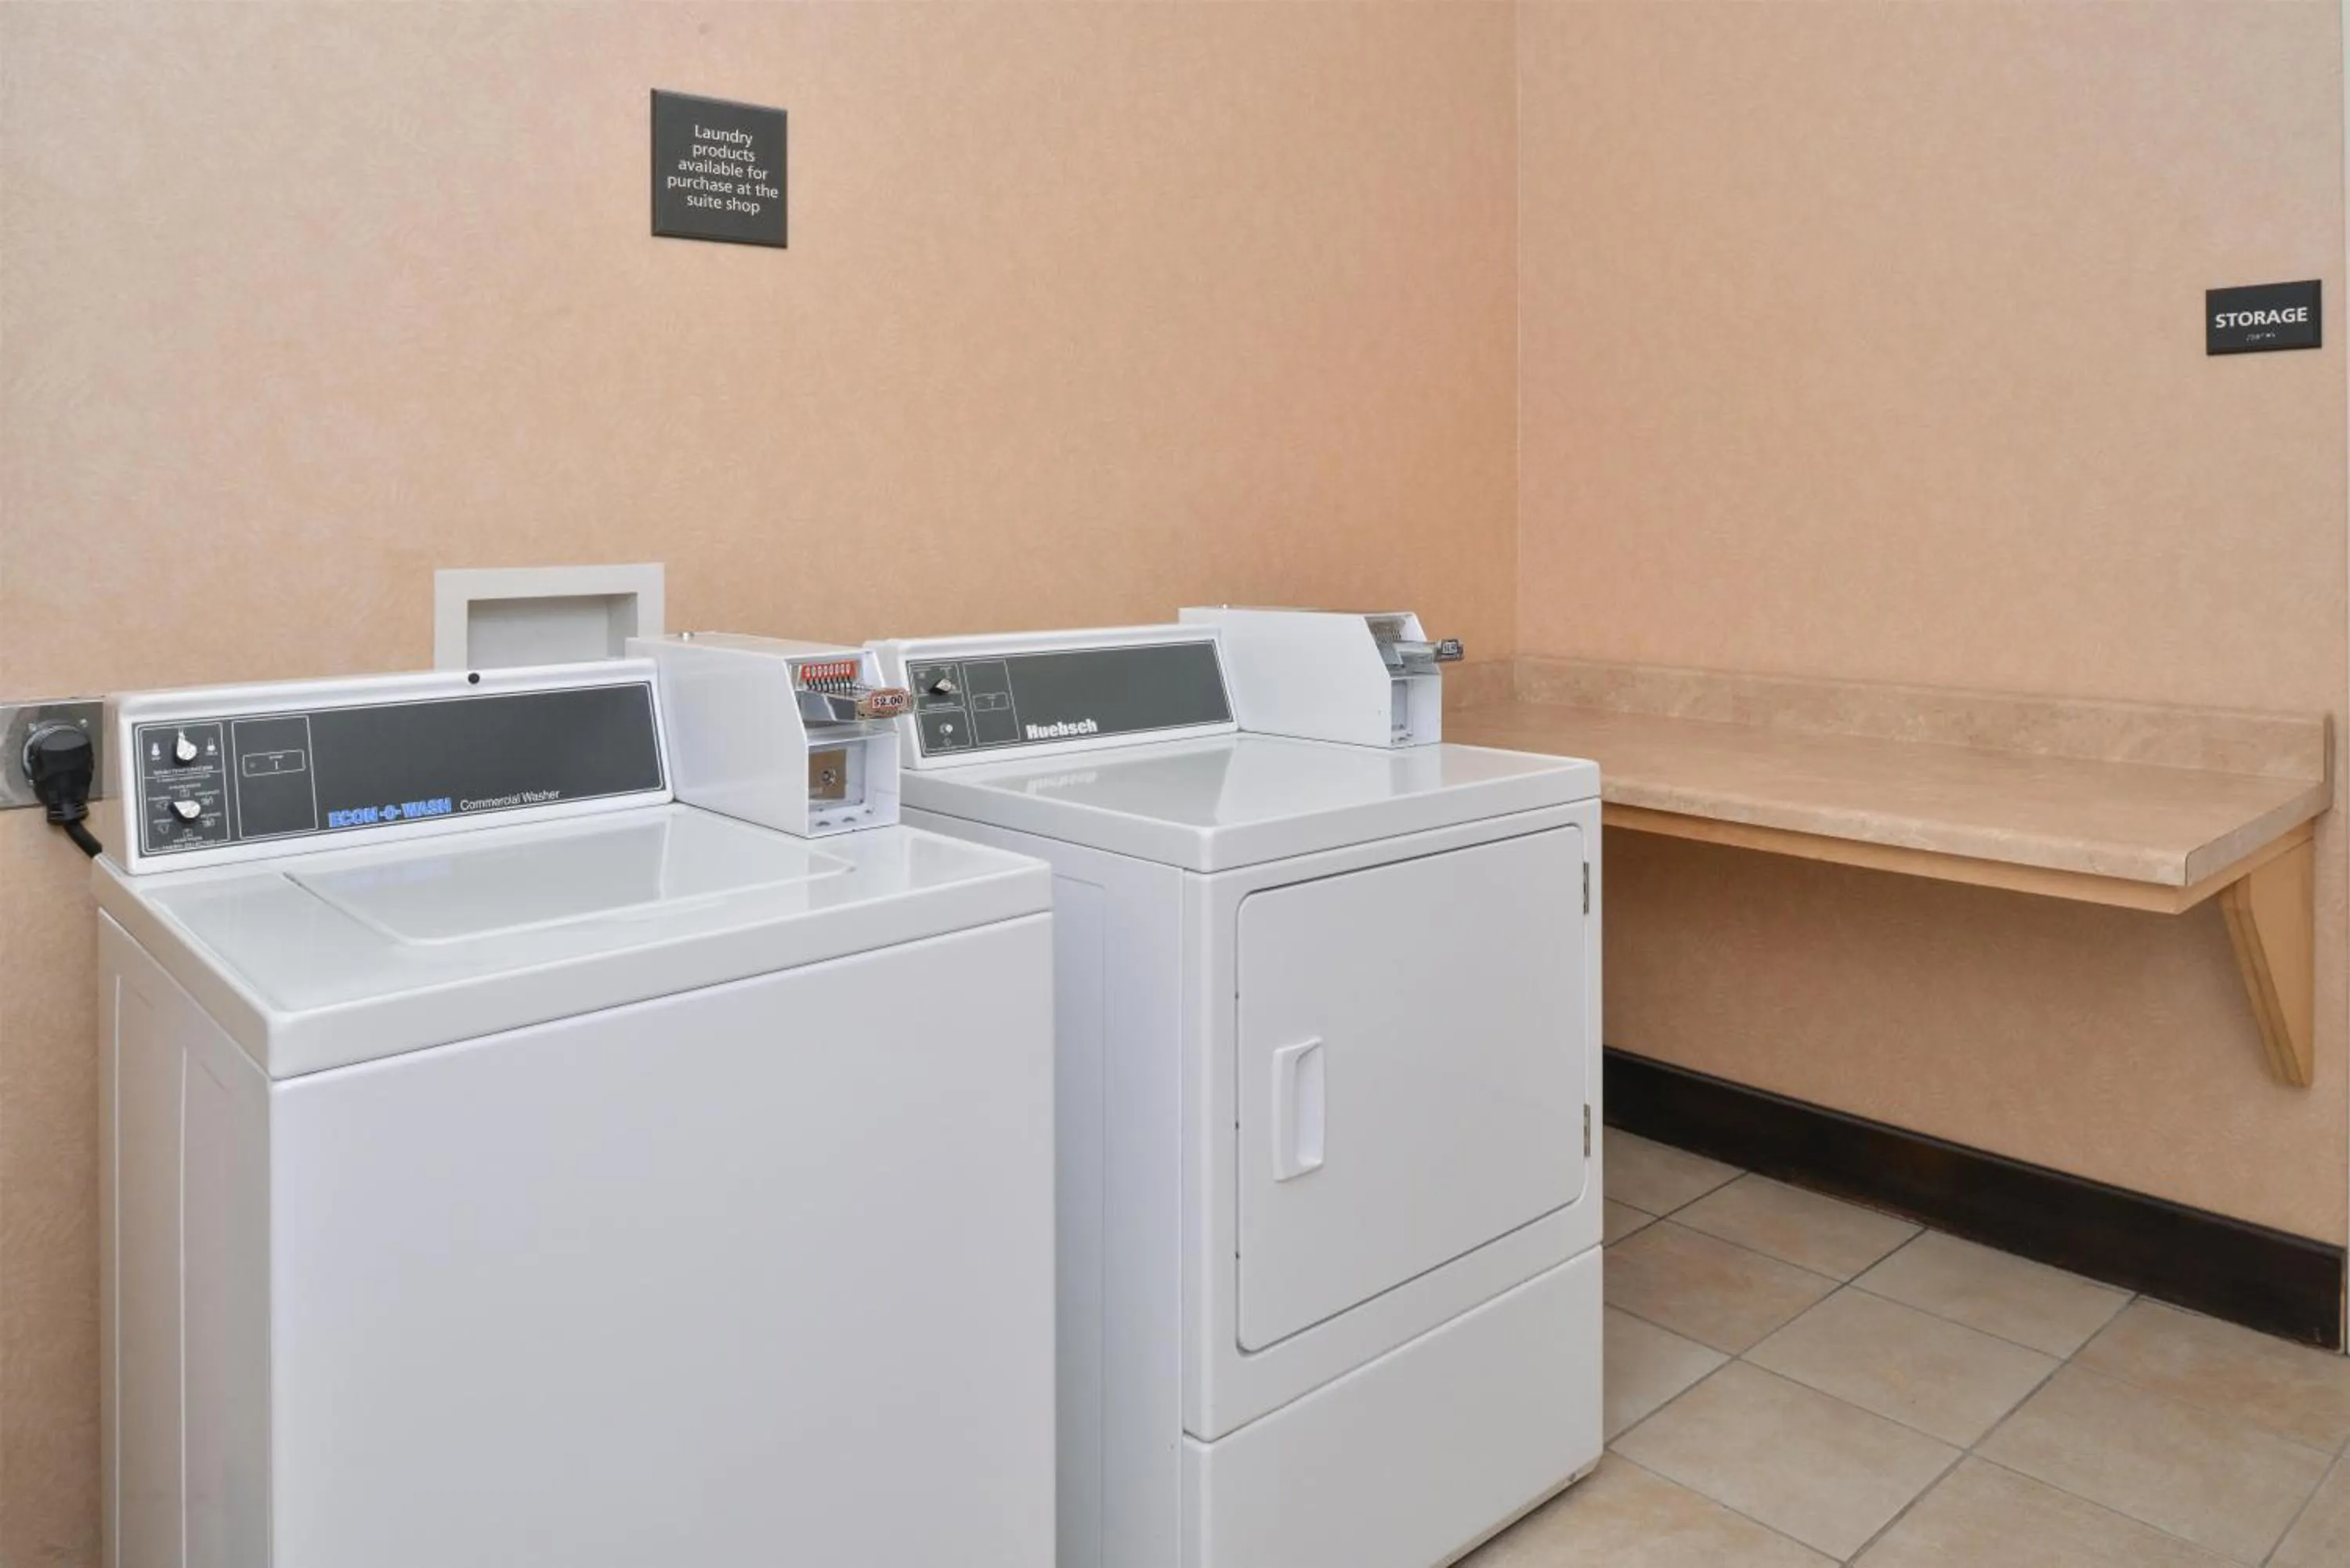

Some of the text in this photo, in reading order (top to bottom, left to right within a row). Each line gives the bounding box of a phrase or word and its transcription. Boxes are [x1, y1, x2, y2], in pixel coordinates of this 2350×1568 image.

[694, 125, 753, 148] Laundry
[692, 144, 755, 163] products
[678, 160, 768, 180] available for
[667, 175, 779, 198] purchase at the
[686, 194, 761, 215] suite shop
[2214, 306, 2308, 329] STORAGE
[873, 695, 903, 707] $2.00
[1025, 718, 1098, 740] Huebsch
[460, 793, 521, 811] Commercial
[520, 789, 561, 804] Washer
